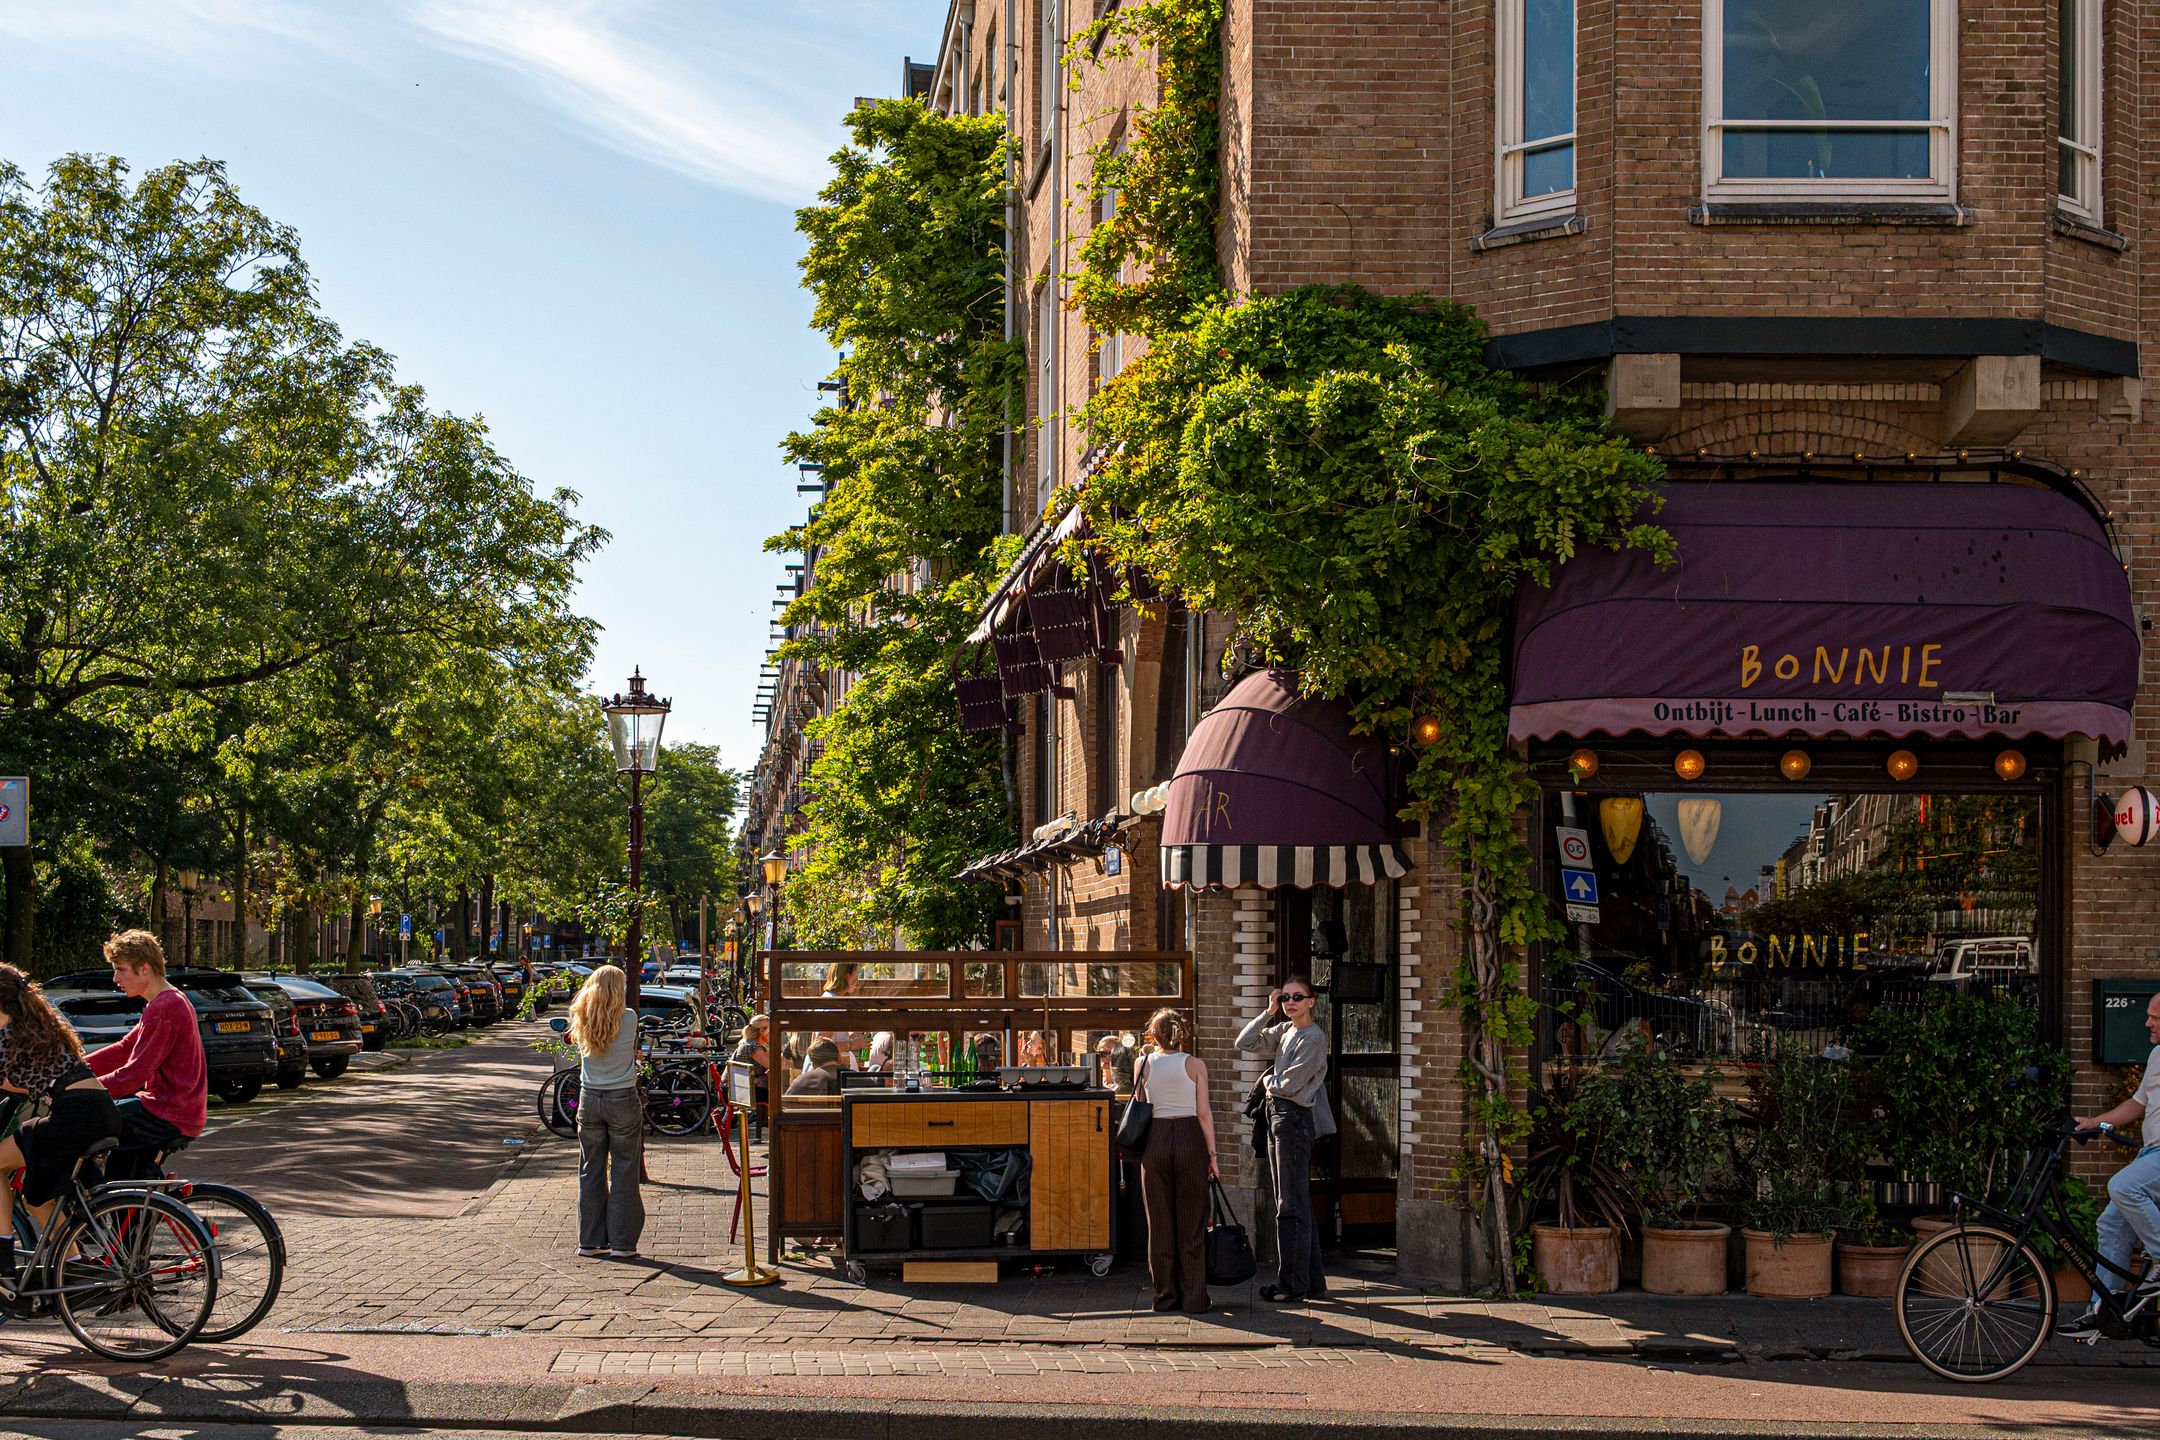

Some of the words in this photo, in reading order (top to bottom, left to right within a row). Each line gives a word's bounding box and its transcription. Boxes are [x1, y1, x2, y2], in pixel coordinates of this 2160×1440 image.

[1653, 701, 1734, 725] Ontbijt
[1750, 702, 1817, 722] Lunch
[1833, 701, 1881, 722] Café
[1898, 703, 1966, 723] Bistro
[1983, 704, 2021, 724] Bar
[1710, 932, 1870, 973] BONNIE
[2105, 997, 2128, 1008] 226
